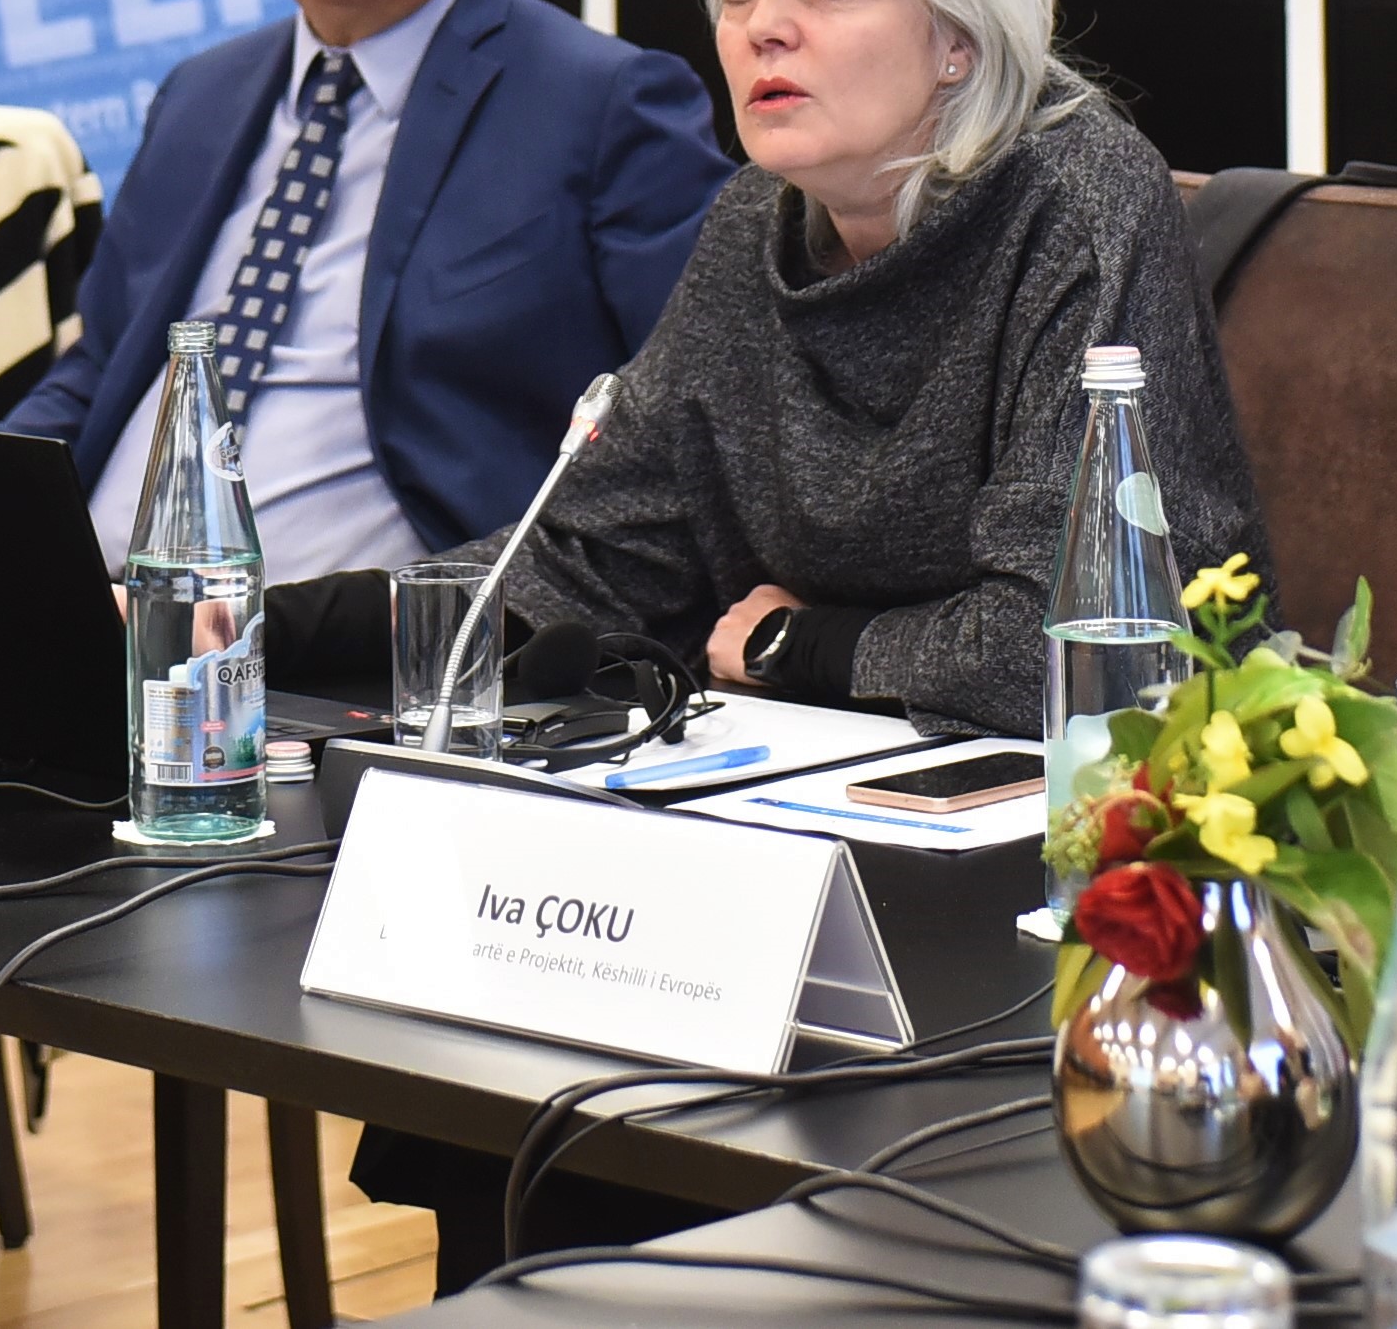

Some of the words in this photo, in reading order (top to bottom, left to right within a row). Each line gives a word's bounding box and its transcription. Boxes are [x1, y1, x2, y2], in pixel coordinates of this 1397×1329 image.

[477, 884, 526, 925] Iva
[535, 894, 635, 943] ÇOKU
[472, 942, 503, 962] artë
[506, 950, 516, 964] e
[519, 948, 586, 979] Projektit,
[592, 961, 648, 988] Këshilli
[659, 973, 723, 1001] Evropës
